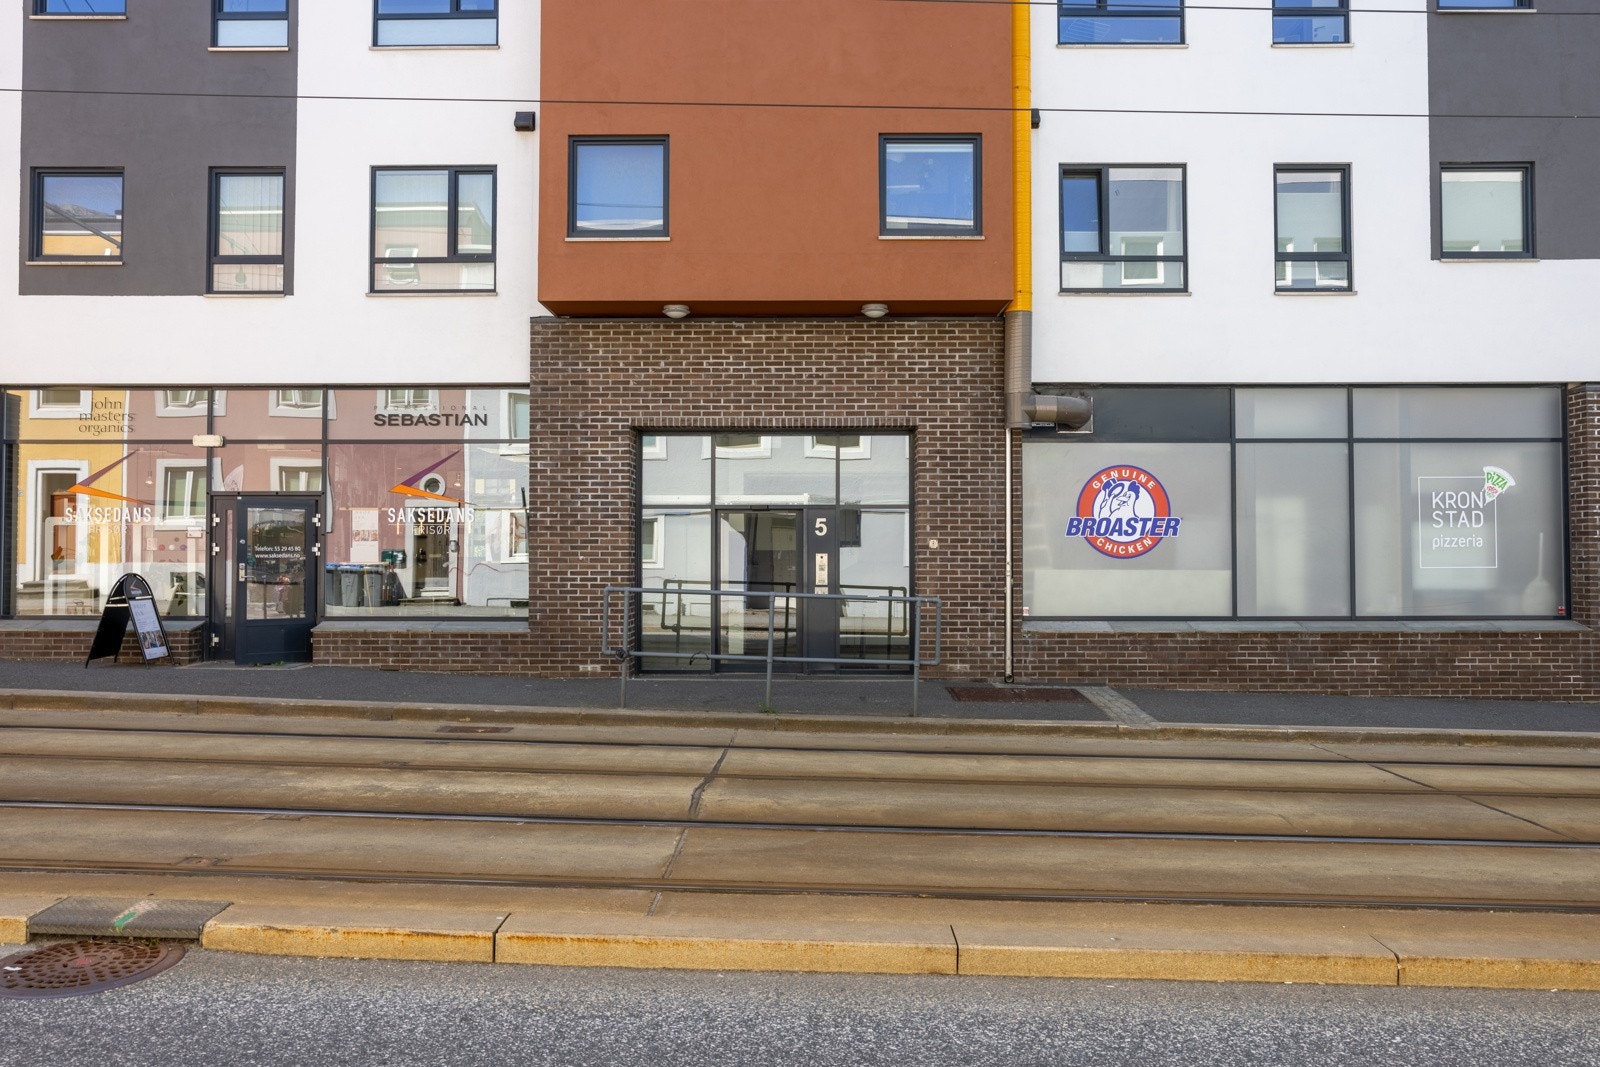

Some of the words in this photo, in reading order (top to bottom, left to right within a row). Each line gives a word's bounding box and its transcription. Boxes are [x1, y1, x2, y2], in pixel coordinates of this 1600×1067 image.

[90, 397, 122, 414] john
[79, 411, 135, 421] masters
[373, 413, 488, 427] SEBASTIAN
[79, 421, 135, 436] organics
[1092, 469, 1156, 490] GENUINE
[1431, 491, 1484, 508] KRON
[65, 507, 152, 523] SAKSEDANS
[387, 507, 475, 523] SAKSEDANS
[1432, 510, 1484, 528] STAD
[814, 517, 828, 536] 5
[1065, 516, 1182, 538] BROASTER
[1096, 537, 1153, 555] CHICKEN
[1432, 534, 1483, 550] pizzeria
